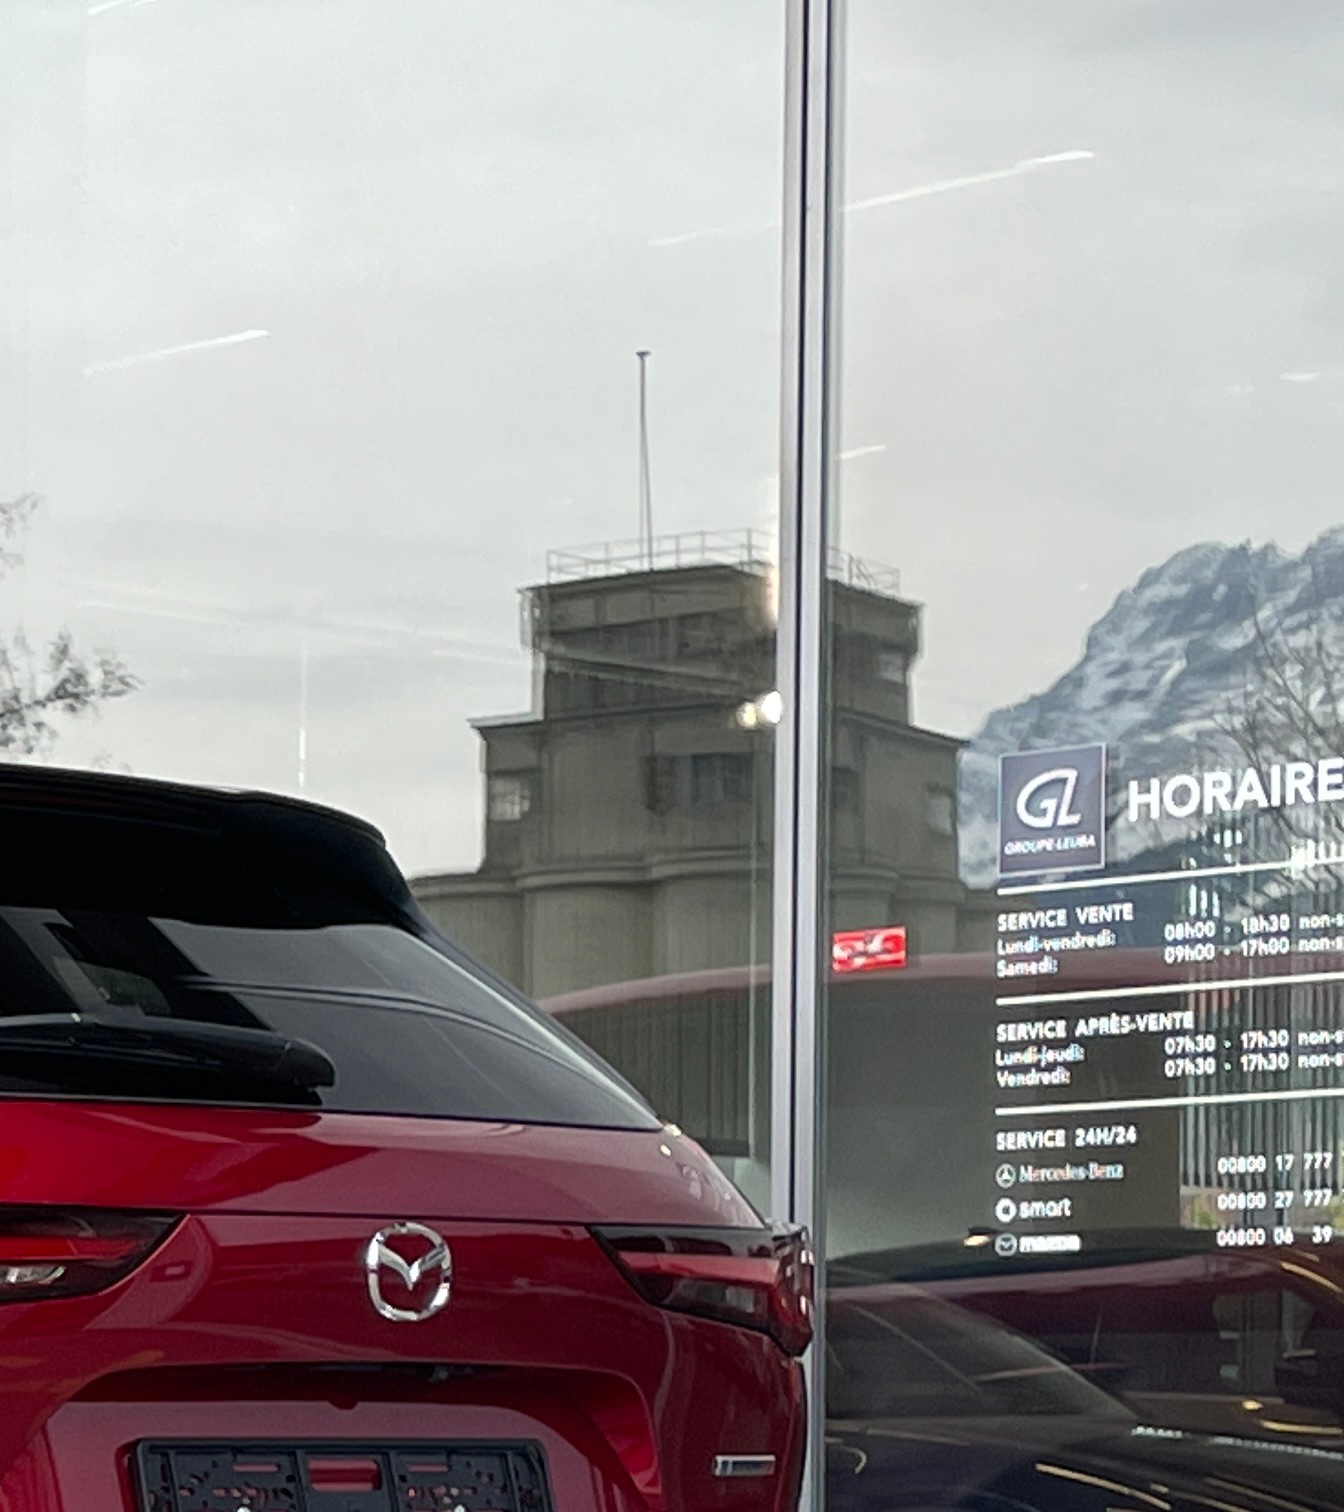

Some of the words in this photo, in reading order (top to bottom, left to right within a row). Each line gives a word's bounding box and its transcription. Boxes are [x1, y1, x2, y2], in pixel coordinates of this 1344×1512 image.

[996, 908, 1068, 932] SERVICE
[1075, 902, 1134, 925] VENTE
[1240, 913, 1291, 936] 18h30
[1164, 942, 1216, 965] 09h00
[1240, 936, 1290, 958] 17h00
[996, 955, 1059, 979] Samedi:
[995, 1019, 1068, 1043] SERVICE
[1074, 1010, 1194, 1038] APRÈS-VENTE
[1164, 1034, 1217, 1056] 07h30
[1240, 1028, 1290, 1050] 17h30
[1164, 1056, 1217, 1078] 07h30
[1240, 1052, 1290, 1073] 17h30
[996, 1128, 1066, 1151] SERVICE
[1074, 1124, 1138, 1147] 24H/24
[1275, 1153, 1295, 1172] 17
[1019, 1197, 1073, 1219] smart
[1273, 1190, 1295, 1210] 27
[1312, 1224, 1333, 1245] 39
